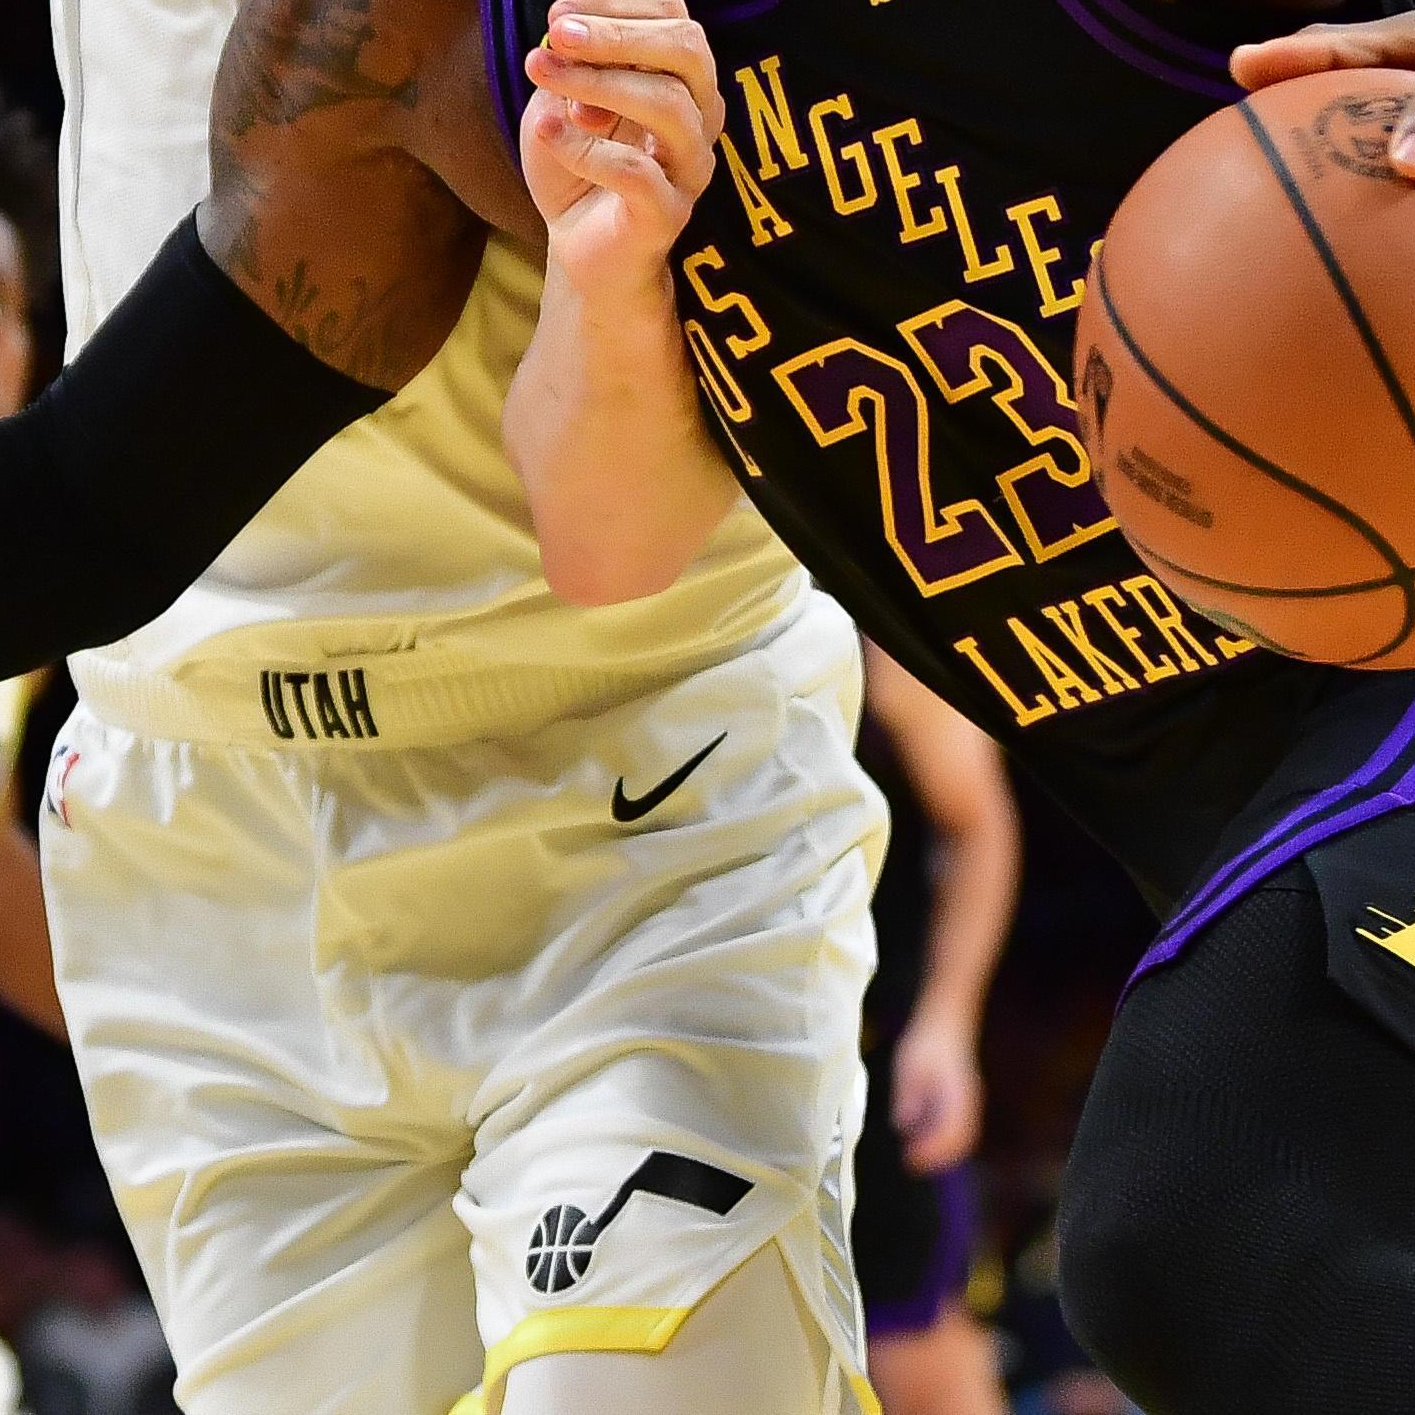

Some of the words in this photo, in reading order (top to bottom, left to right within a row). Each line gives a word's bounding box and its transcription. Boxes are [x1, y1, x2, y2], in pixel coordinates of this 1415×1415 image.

[718, 54, 1103, 319] ANGELE
[771, 298, 1121, 598] 23
[259, 666, 380, 740] UTAH
[952, 573, 1260, 728] LAKER
